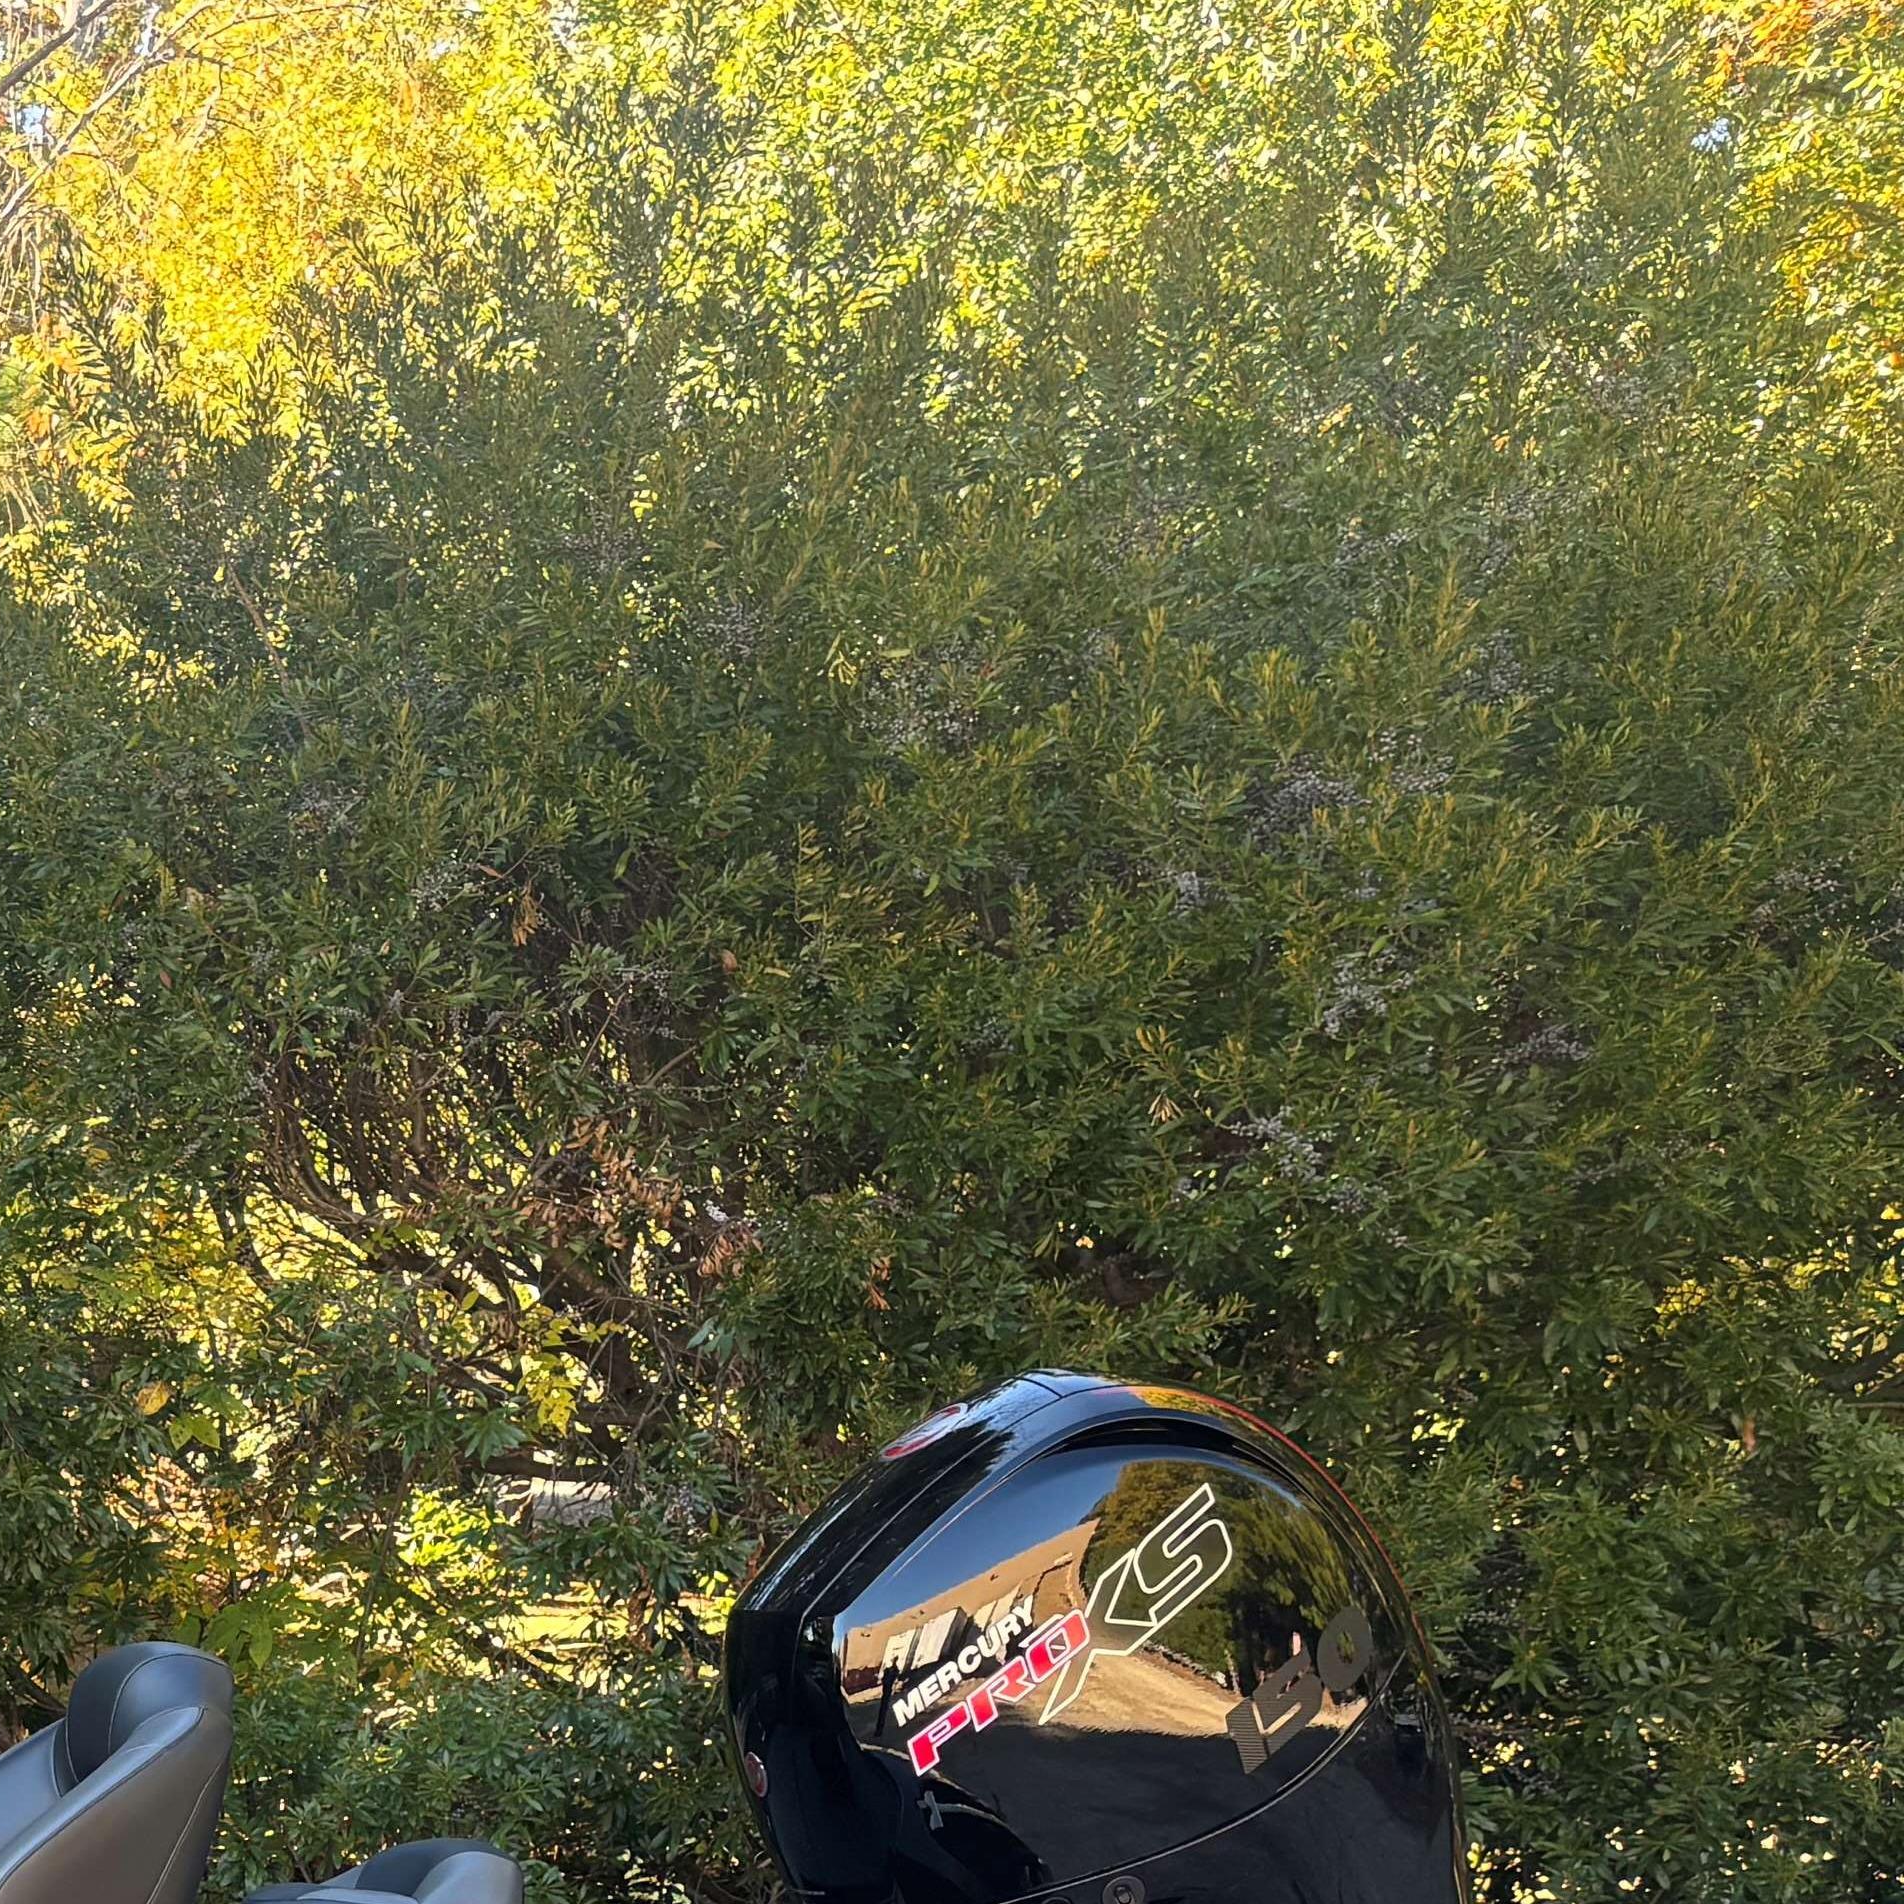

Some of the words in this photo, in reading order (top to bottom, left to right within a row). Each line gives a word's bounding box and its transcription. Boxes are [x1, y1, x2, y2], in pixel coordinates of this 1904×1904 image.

[892, 1595, 1034, 1727] MERCURY
[907, 1608, 1090, 1777] PRO
[1038, 1482, 1234, 1726] XS
[1225, 1605, 1375, 1775] 150
